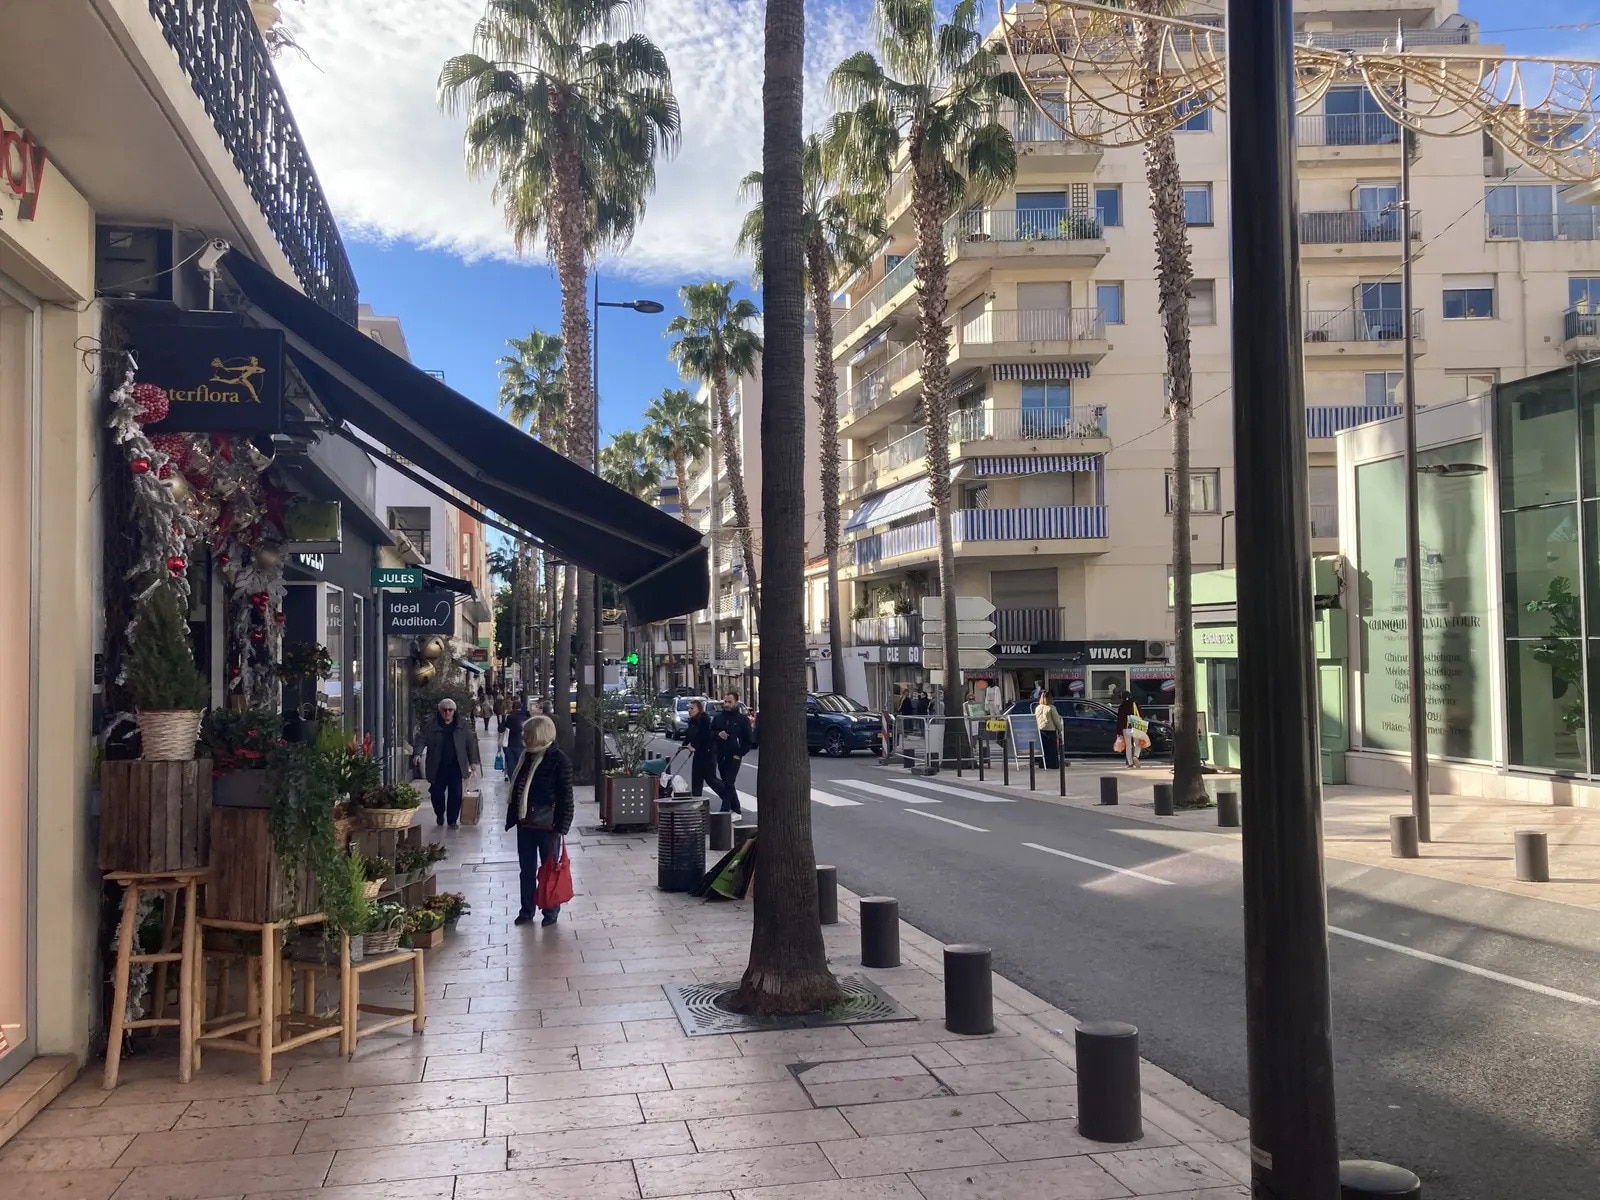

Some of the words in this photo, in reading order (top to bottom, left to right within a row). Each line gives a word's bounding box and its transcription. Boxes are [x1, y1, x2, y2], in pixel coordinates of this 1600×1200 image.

[166, 384, 240, 403] terflora
[378, 573, 415, 584] JULES
[390, 603, 420, 613] Ideal
[391, 616, 437, 627] Audition
[1368, 618, 1408, 634] CLINIQU
[886, 647, 899, 662] CLE
[908, 647, 919, 662] GO
[1001, 645, 1031, 654] VIVACI
[1089, 647, 1132, 659] VIVACI
